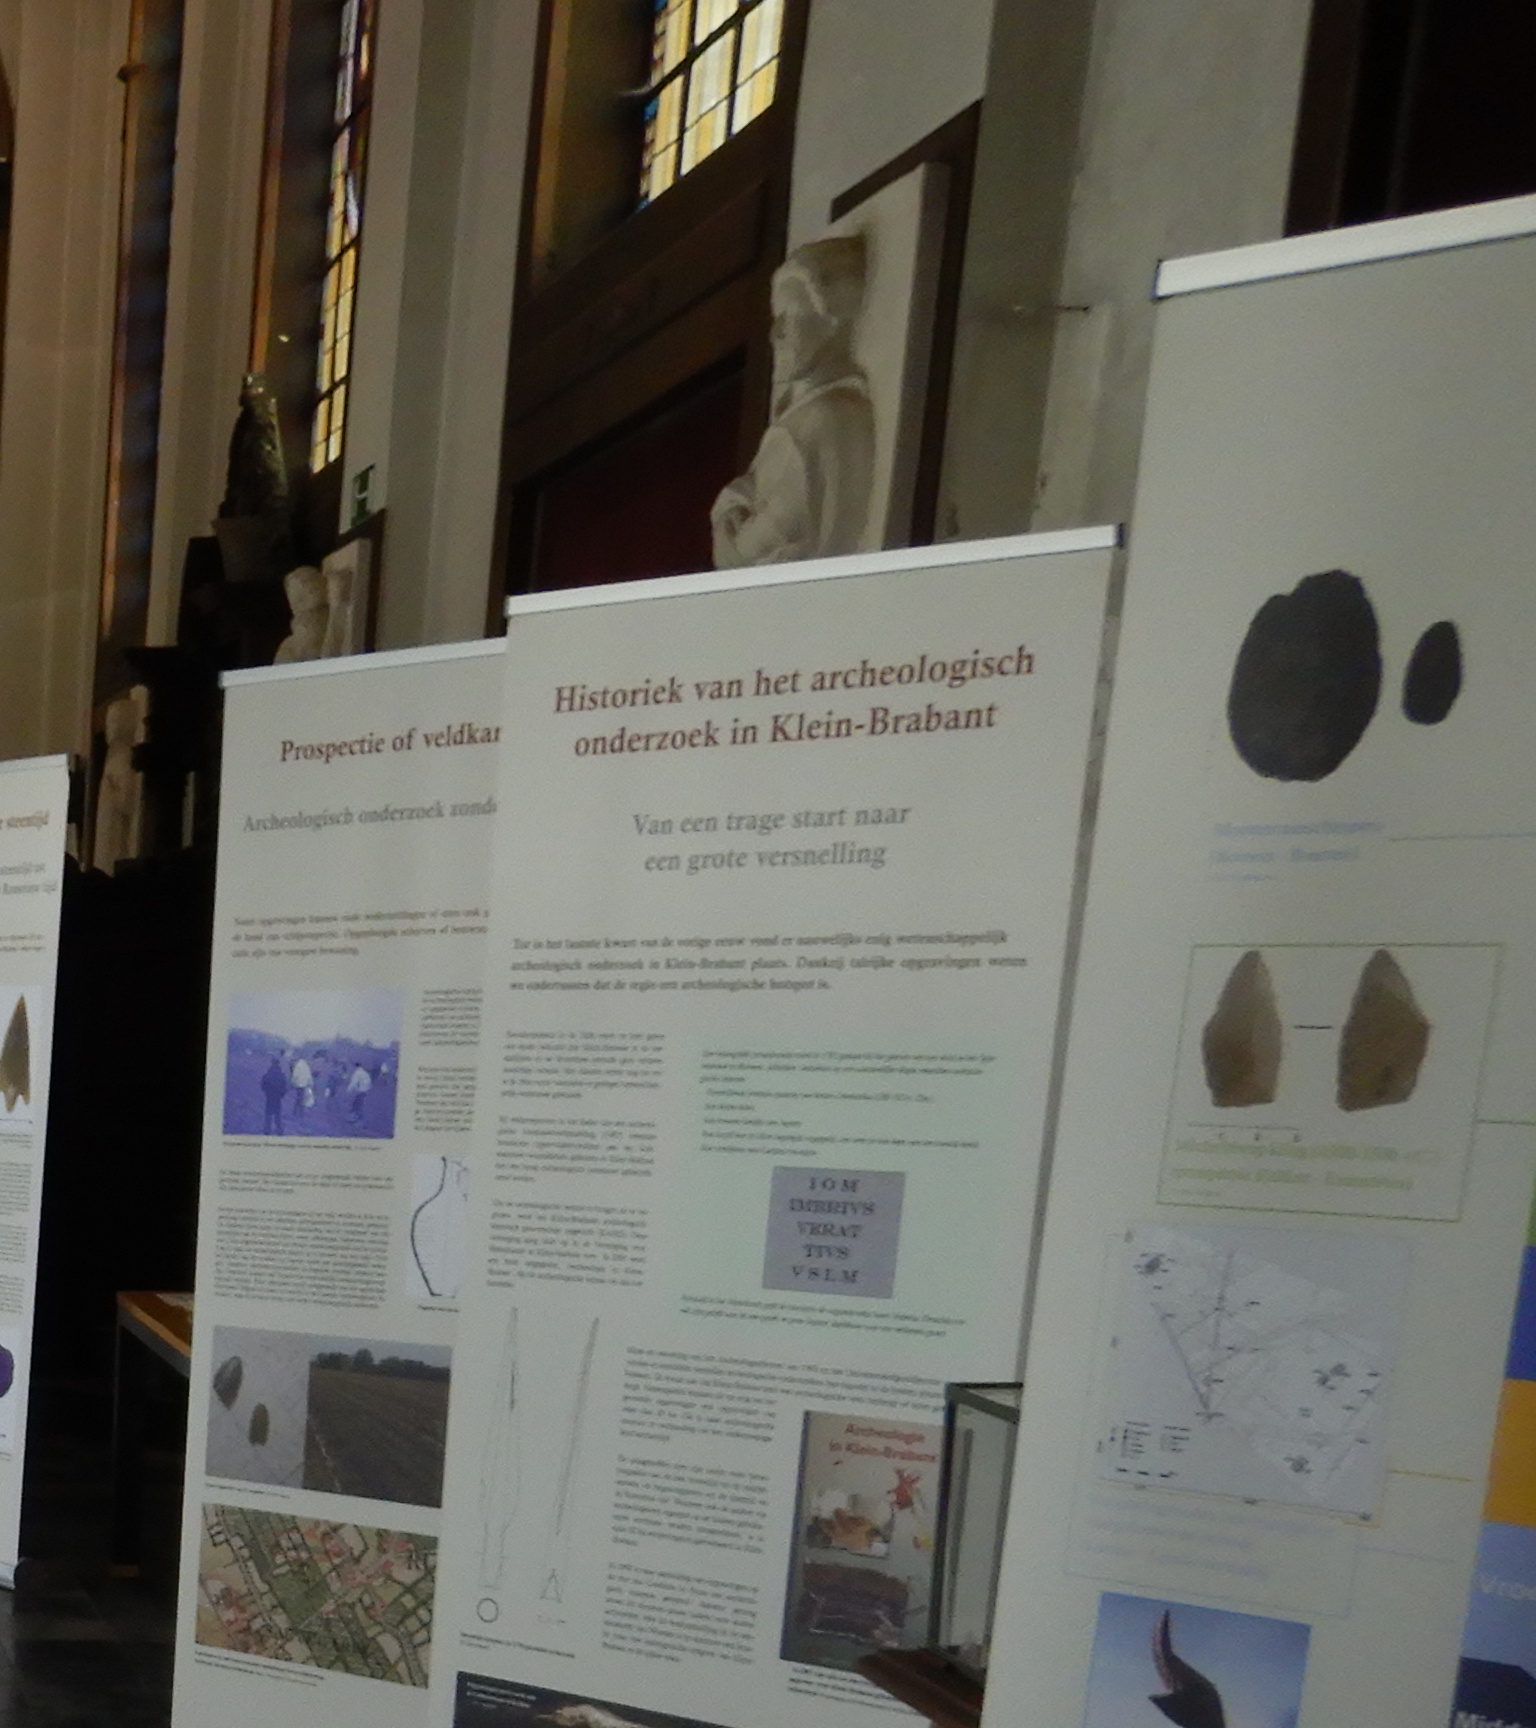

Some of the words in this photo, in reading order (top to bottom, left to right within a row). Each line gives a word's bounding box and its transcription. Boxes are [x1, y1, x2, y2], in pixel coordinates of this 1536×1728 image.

[553, 676, 685, 713] Historiek
[694, 678, 743, 702] van
[753, 667, 800, 697] het
[810, 644, 1035, 691] archeologisch
[279, 732, 385, 764] Prospectie
[392, 727, 418, 752] of
[574, 719, 720, 757] onderzoek
[730, 717, 758, 745] in
[769, 702, 999, 742] Klein-Brabant
[243, 806, 353, 833] Archeologisch
[359, 799, 445, 824] onderzoek
[632, 813, 674, 836] Van
[680, 815, 718, 833] een
[726, 810, 786, 837] trage
[792, 806, 847, 829] start
[854, 806, 912, 827] naar
[644, 852, 681, 872] een
[686, 848, 748, 876] grote
[757, 840, 888, 870] versnelling
[821, 1177, 835, 1191] O
[840, 1178, 860, 1193] M
[841, 1269, 859, 1284] M
